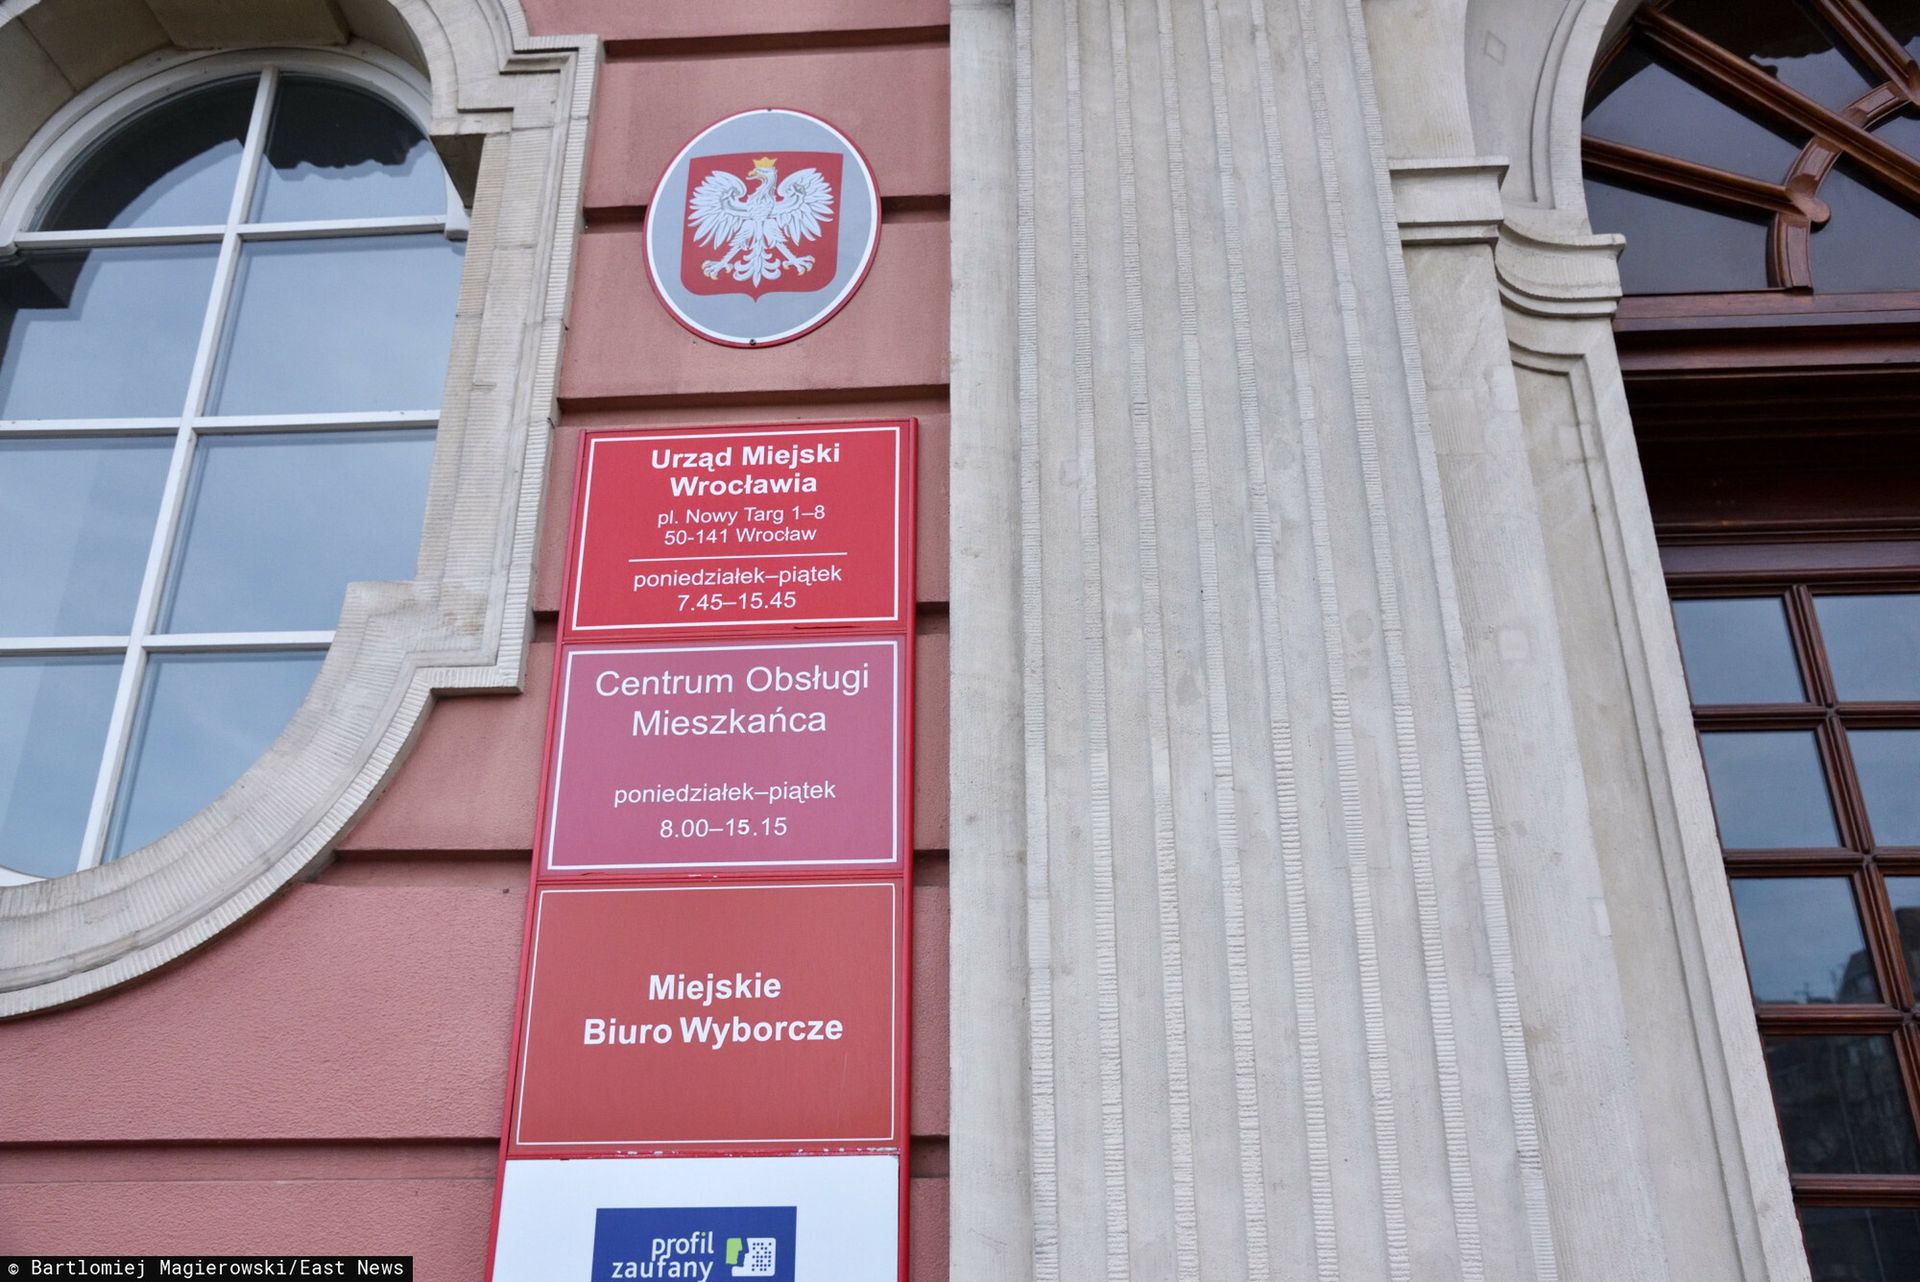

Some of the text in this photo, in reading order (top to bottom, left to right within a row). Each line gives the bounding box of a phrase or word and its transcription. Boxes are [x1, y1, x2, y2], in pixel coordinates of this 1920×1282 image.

[651, 443, 840, 473] Urząd Miejski
[669, 473, 818, 497] Wrocławia
[657, 509, 679, 527] pl.
[685, 508, 739, 526] Nowy
[743, 506, 785, 525] Targ
[664, 526, 817, 546] 50-141 Wrocław
[595, 662, 870, 697] Centrum Obsługi
[632, 706, 827, 737] Mieszkańca
[648, 972, 782, 1007] Miejskie
[583, 1015, 844, 1050] Biuro Wyborcze
[651, 1230, 715, 1262] profil
[611, 1255, 714, 1282] zaufany
